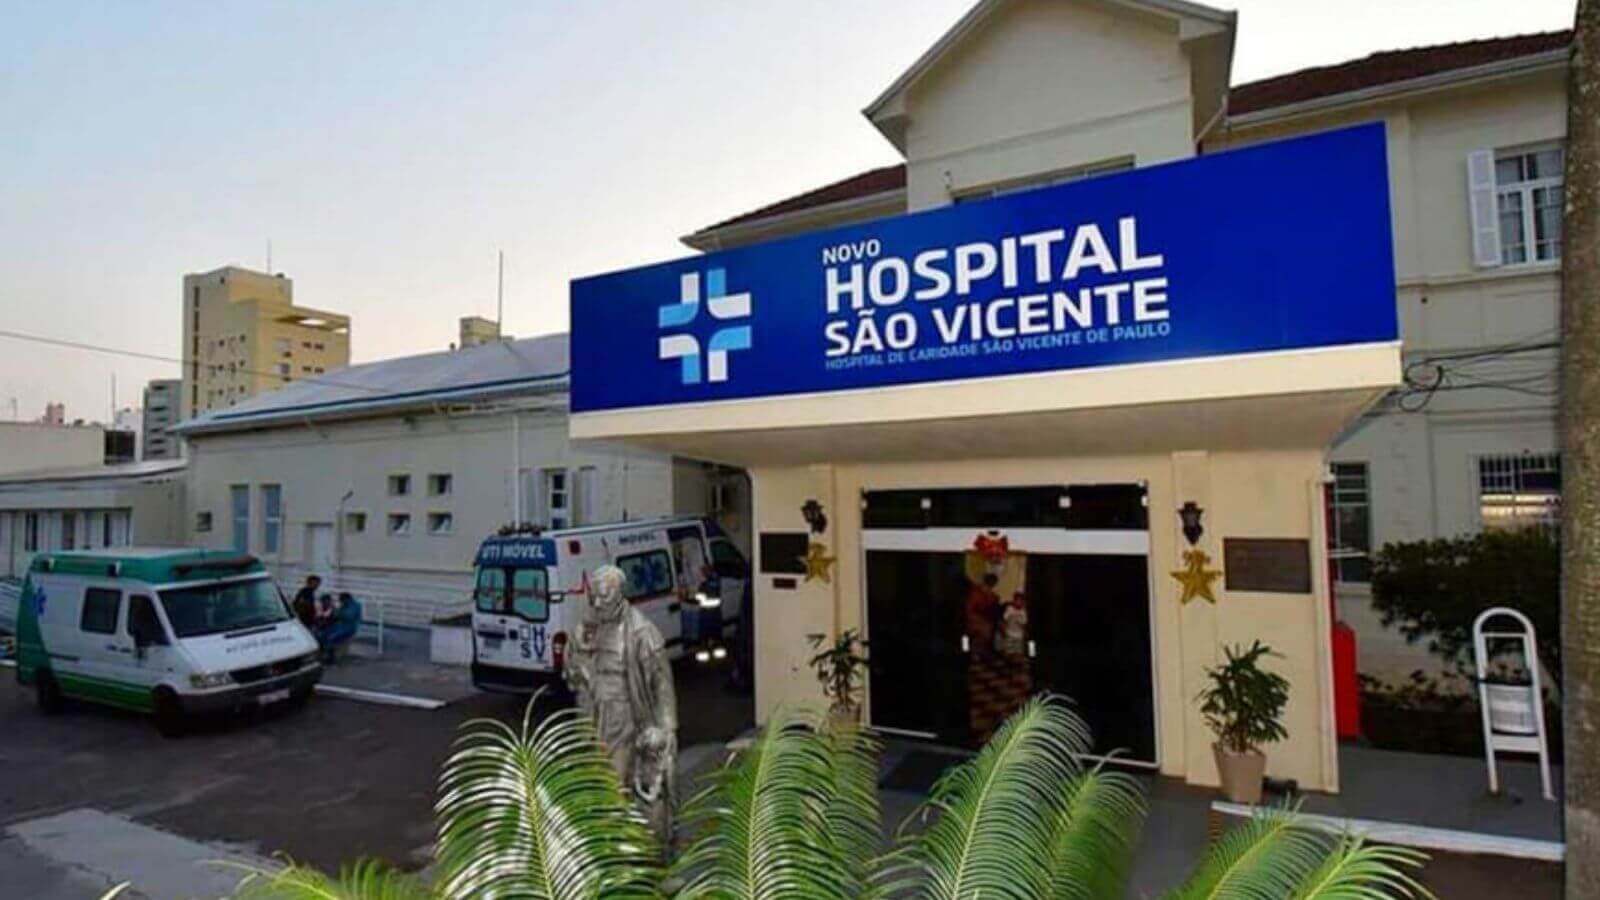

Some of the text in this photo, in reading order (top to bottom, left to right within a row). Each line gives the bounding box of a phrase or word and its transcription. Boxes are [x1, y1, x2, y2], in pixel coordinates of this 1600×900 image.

[823, 239, 881, 264] NOVO
[825, 216, 1163, 313] HOSPITAL
[825, 277, 1170, 356] SÃO VICENTE
[825, 354, 884, 370] HOSPITAL
[888, 351, 904, 363] DE
[908, 344, 977, 362] CARIDADE
[1016, 331, 1082, 350] VICENTE
[1086, 328, 1109, 344] DE
[1113, 322, 1171, 342] PAULO
